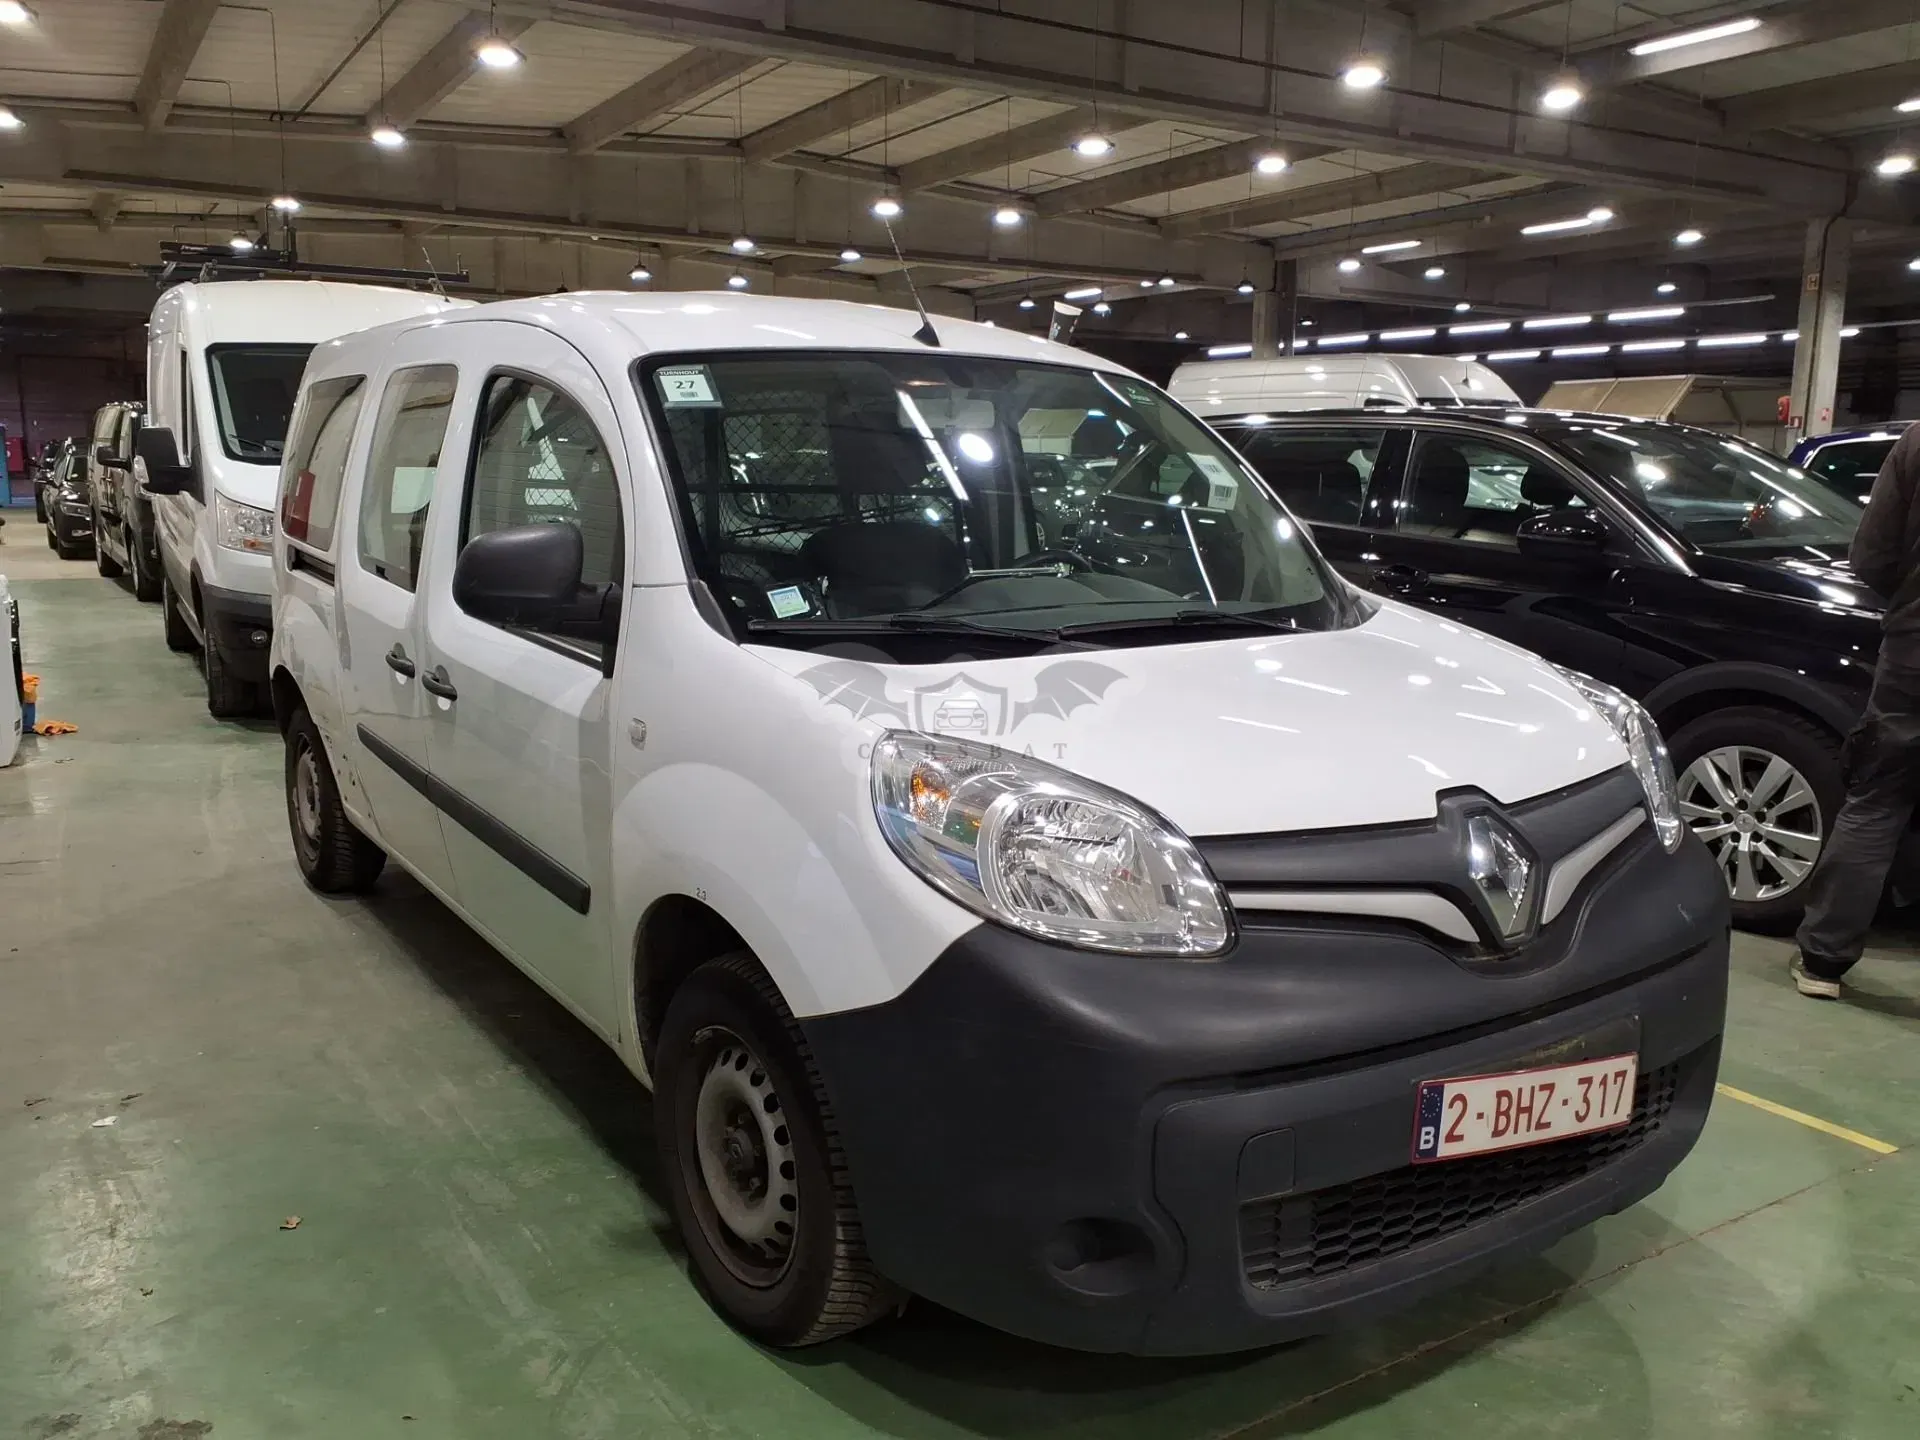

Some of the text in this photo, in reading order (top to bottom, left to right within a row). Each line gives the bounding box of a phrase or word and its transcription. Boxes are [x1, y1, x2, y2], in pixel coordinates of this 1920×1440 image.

[674, 380, 695, 389] 27
[1444, 1069, 1628, 1144] 2-BHZ-317
[1419, 1126, 1435, 1150] B
